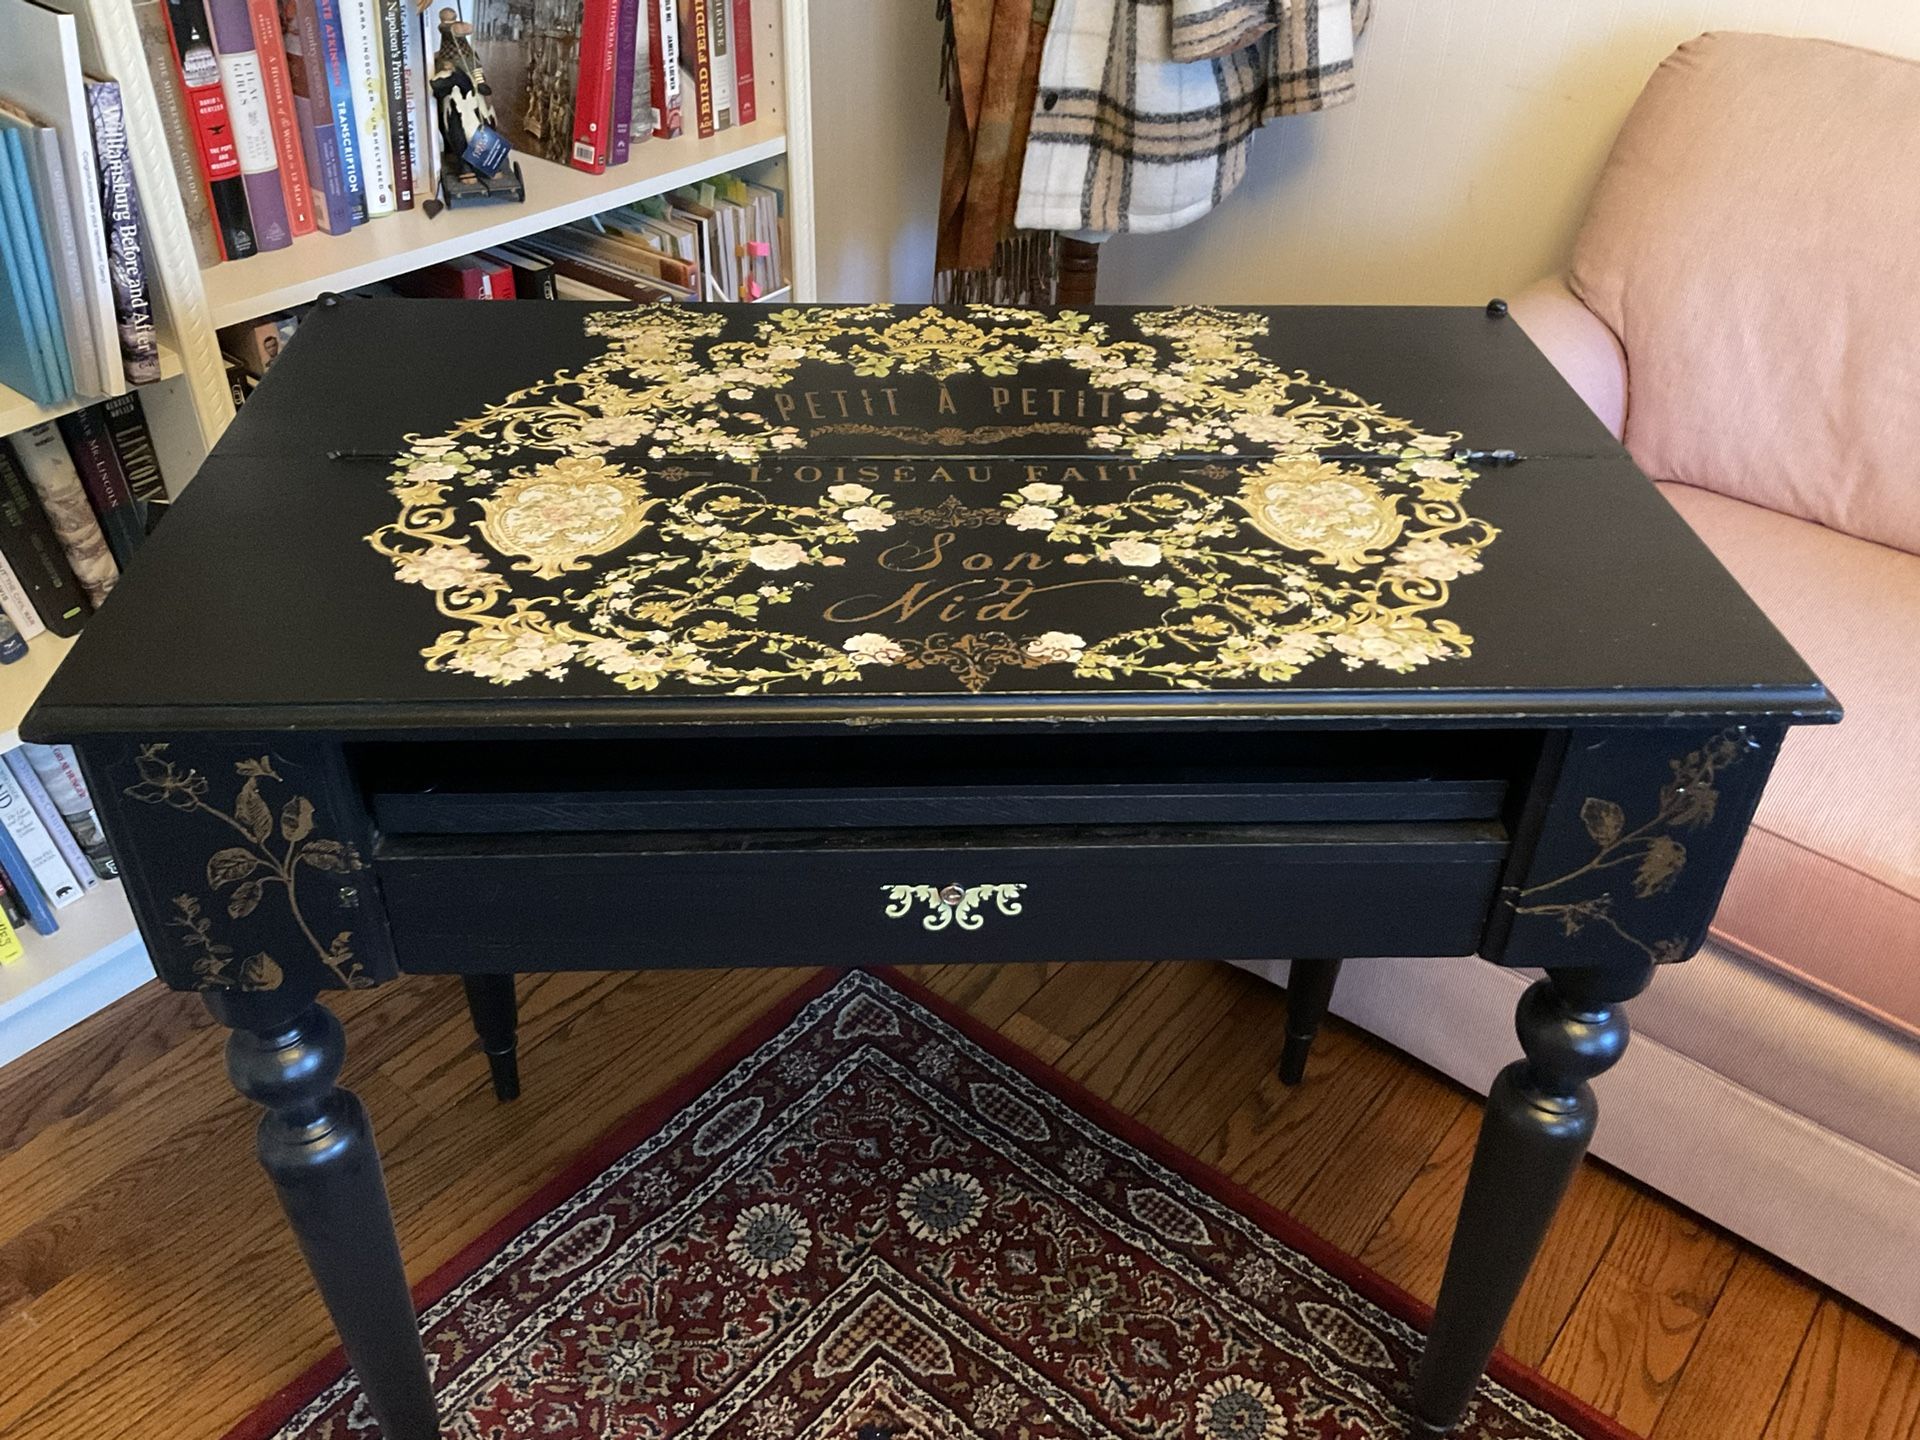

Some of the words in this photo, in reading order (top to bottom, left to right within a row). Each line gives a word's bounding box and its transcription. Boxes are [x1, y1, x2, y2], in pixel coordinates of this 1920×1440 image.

[385, 1, 401, 59] Napoleon's
[715, 0, 725, 47] IRONE
[158, 56, 169, 77] THE
[325, 24, 341, 87] ATKINSON
[233, 62, 248, 106] GIRLS
[243, 62, 258, 100] LILAC
[391, 60, 402, 100] Privates
[700, 67, 711, 115] BIRD
[163, 80, 184, 140] MISTRESSES
[362, 36, 374, 102] KINGSOLVER
[371, 117, 384, 190] UNSHELTERED
[271, 66, 283, 105] HISTORY
[283, 128, 293, 161] WORLD
[293, 183, 302, 207] MAPS
[337, 101, 359, 193] TRANSCRIPTION
[102, 104, 131, 221] Williamsburg
[181, 152, 199, 202] CLIVEDEN
[119, 224, 141, 279] Before
[129, 278, 149, 308] and
[133, 311, 154, 351] After
[96, 460, 119, 508] LINCOLN
[115, 425, 163, 501] LINCOLN
[748, 464, 992, 483] L'OISEAU
[1022, 464, 1146, 483] FAIT
[876, 531, 1053, 573] Son
[822, 576, 1125, 624] Nid
